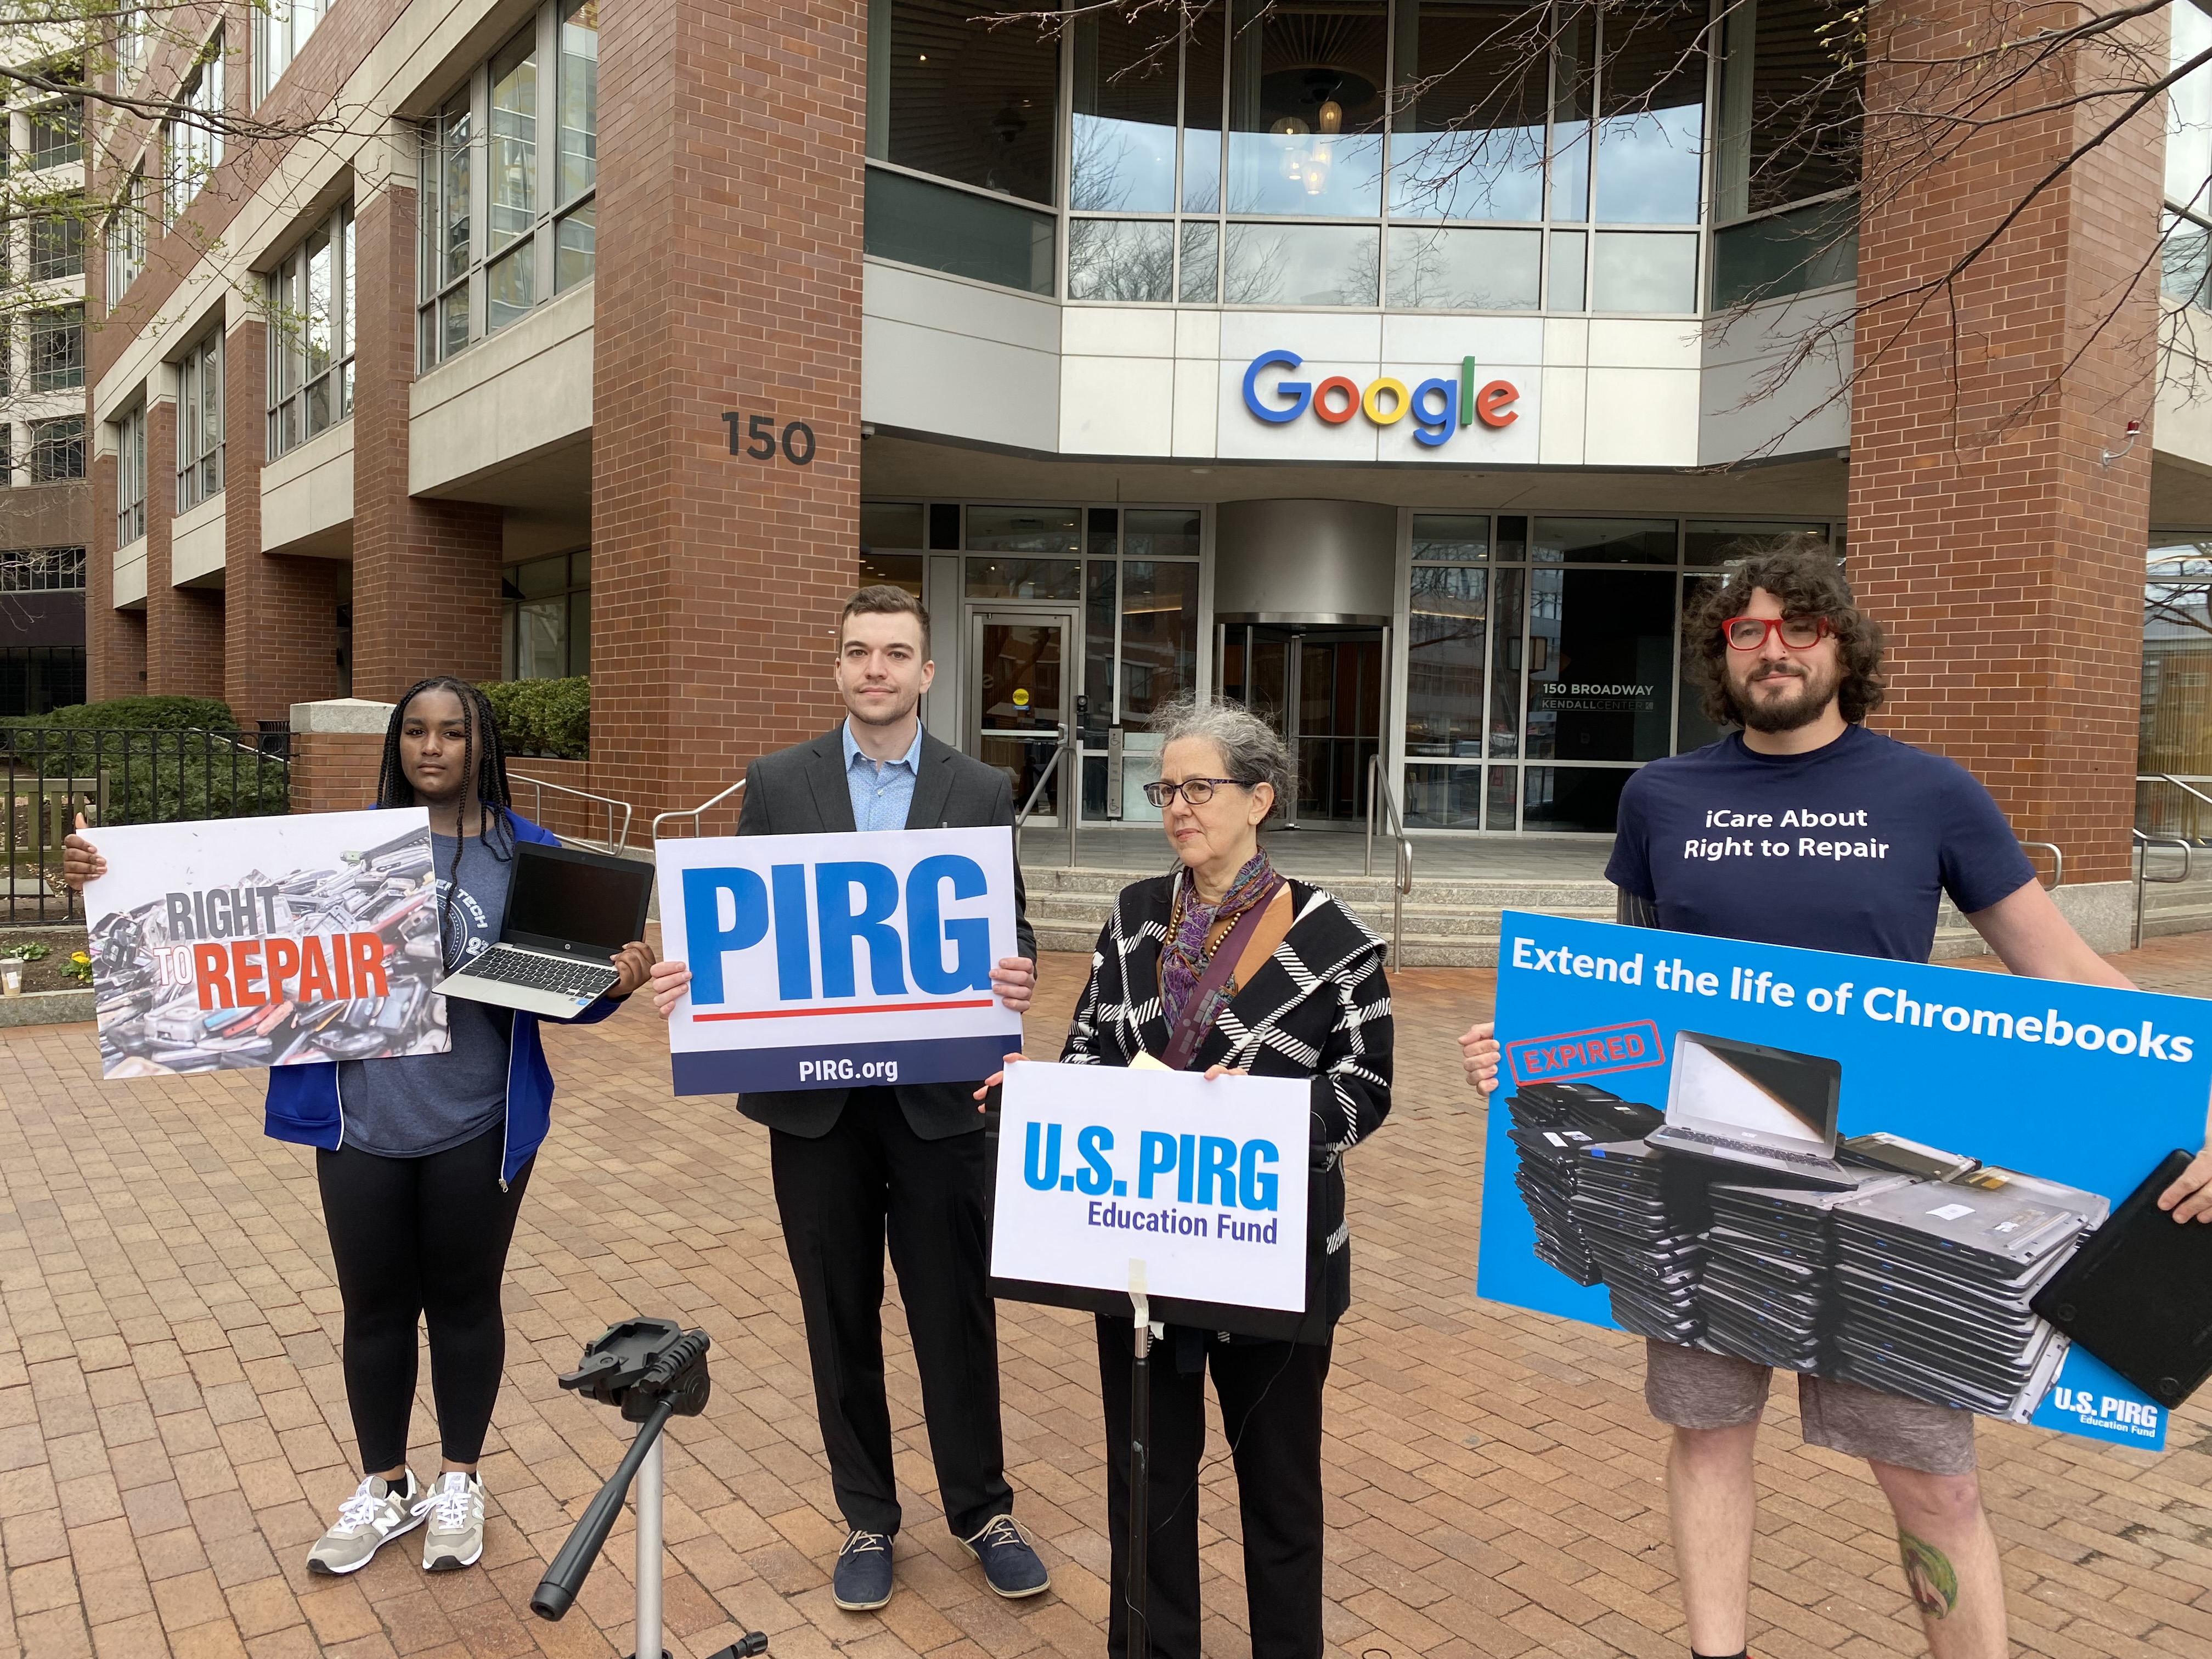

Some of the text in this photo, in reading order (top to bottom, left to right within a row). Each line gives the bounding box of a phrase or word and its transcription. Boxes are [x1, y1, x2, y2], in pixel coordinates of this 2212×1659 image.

[1243, 349, 1520, 446] Google
[721, 412, 815, 465] 150
[1543, 684, 1654, 696] 150 BROADWAY
[1705, 809, 1868, 828] iCare About
[1684, 837, 1889, 861] Right to Repair
[166, 886, 279, 941] RIGHT
[456, 888, 488, 928] TECH
[681, 854, 992, 1005] PIRG
[154, 932, 390, 1011] TO REPAIR
[1512, 937, 2194, 1063] Extend the life of Chromebooks
[799, 1058, 898, 1082] PIRG.org
[1523, 1034, 1645, 1074] EXPIRED
[1024, 1121, 1279, 1212] U.S. PIRG
[1088, 1201, 1277, 1244] Education Fund
[2055, 1386, 2158, 1429] U.S. PIRG
[2080, 1414, 2155, 1438] Education Fund
